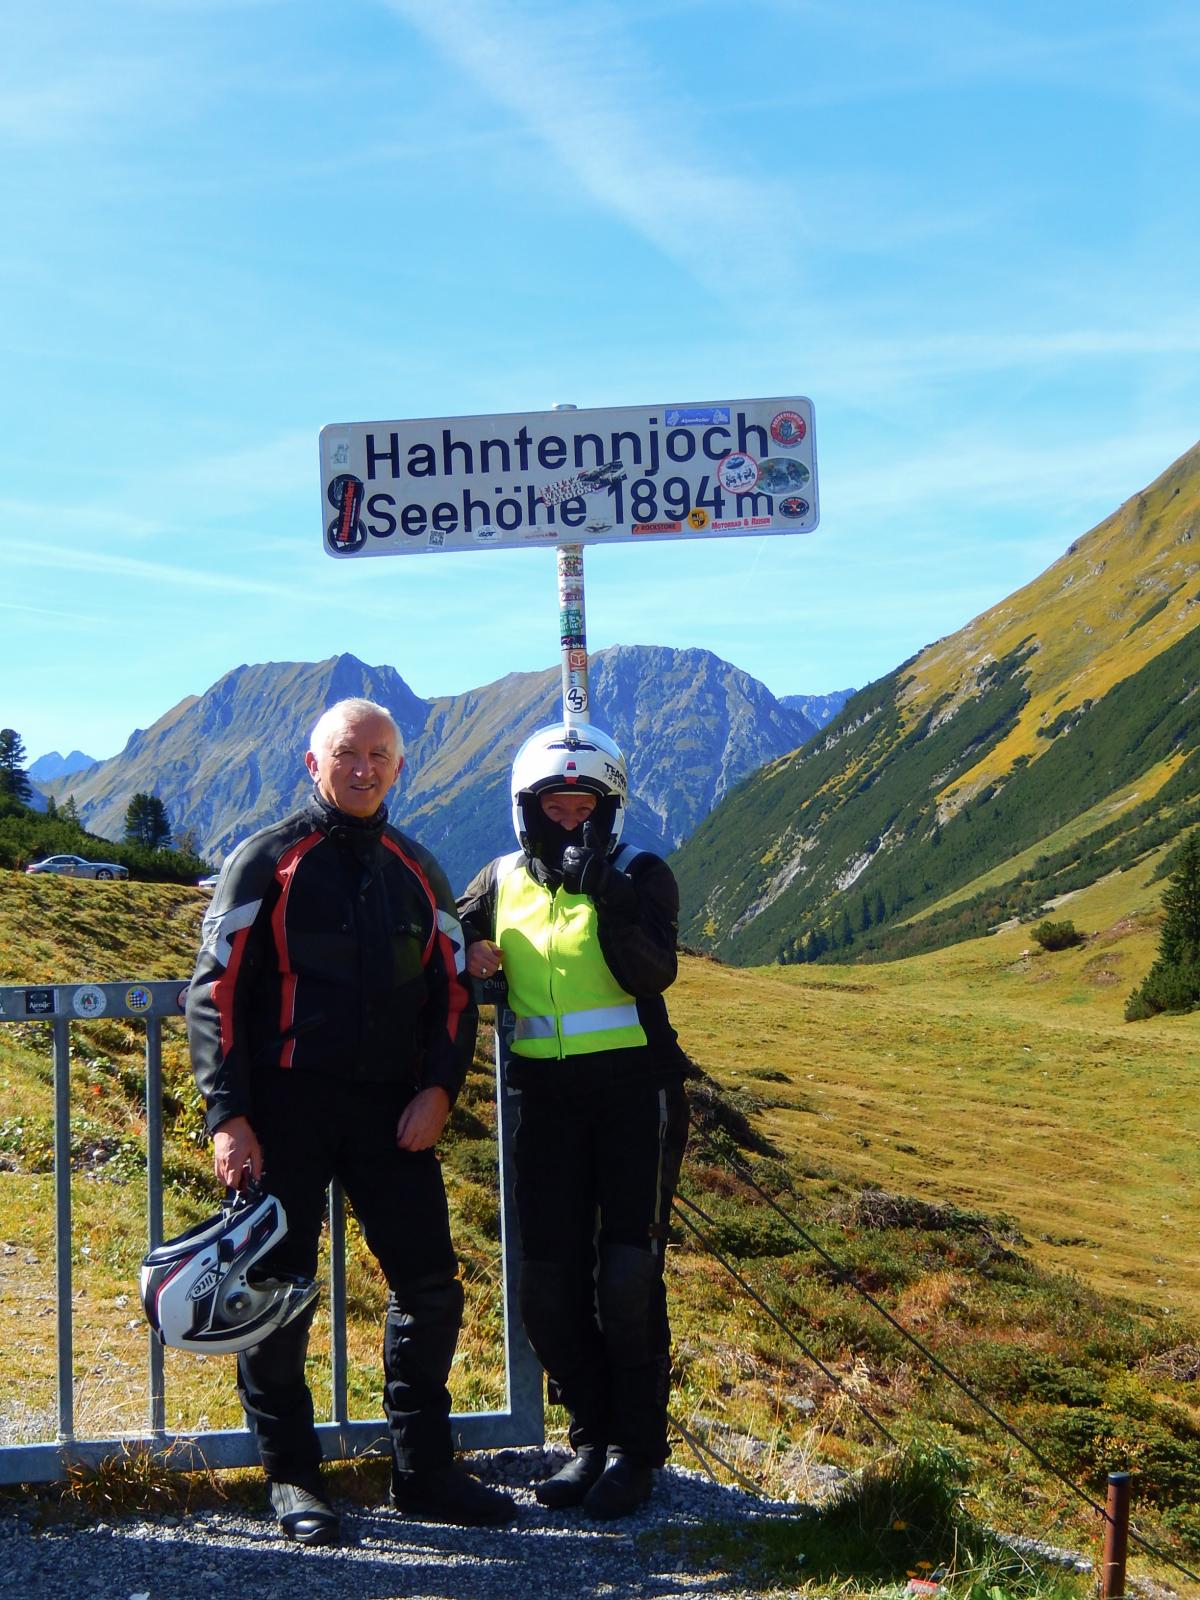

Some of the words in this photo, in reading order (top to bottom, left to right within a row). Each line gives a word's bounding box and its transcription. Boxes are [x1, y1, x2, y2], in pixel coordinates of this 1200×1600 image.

[366, 412, 769, 480] Hahntennjoch
[367, 485, 587, 538] Seehöhe
[193, 1264, 226, 1296] X-lite
